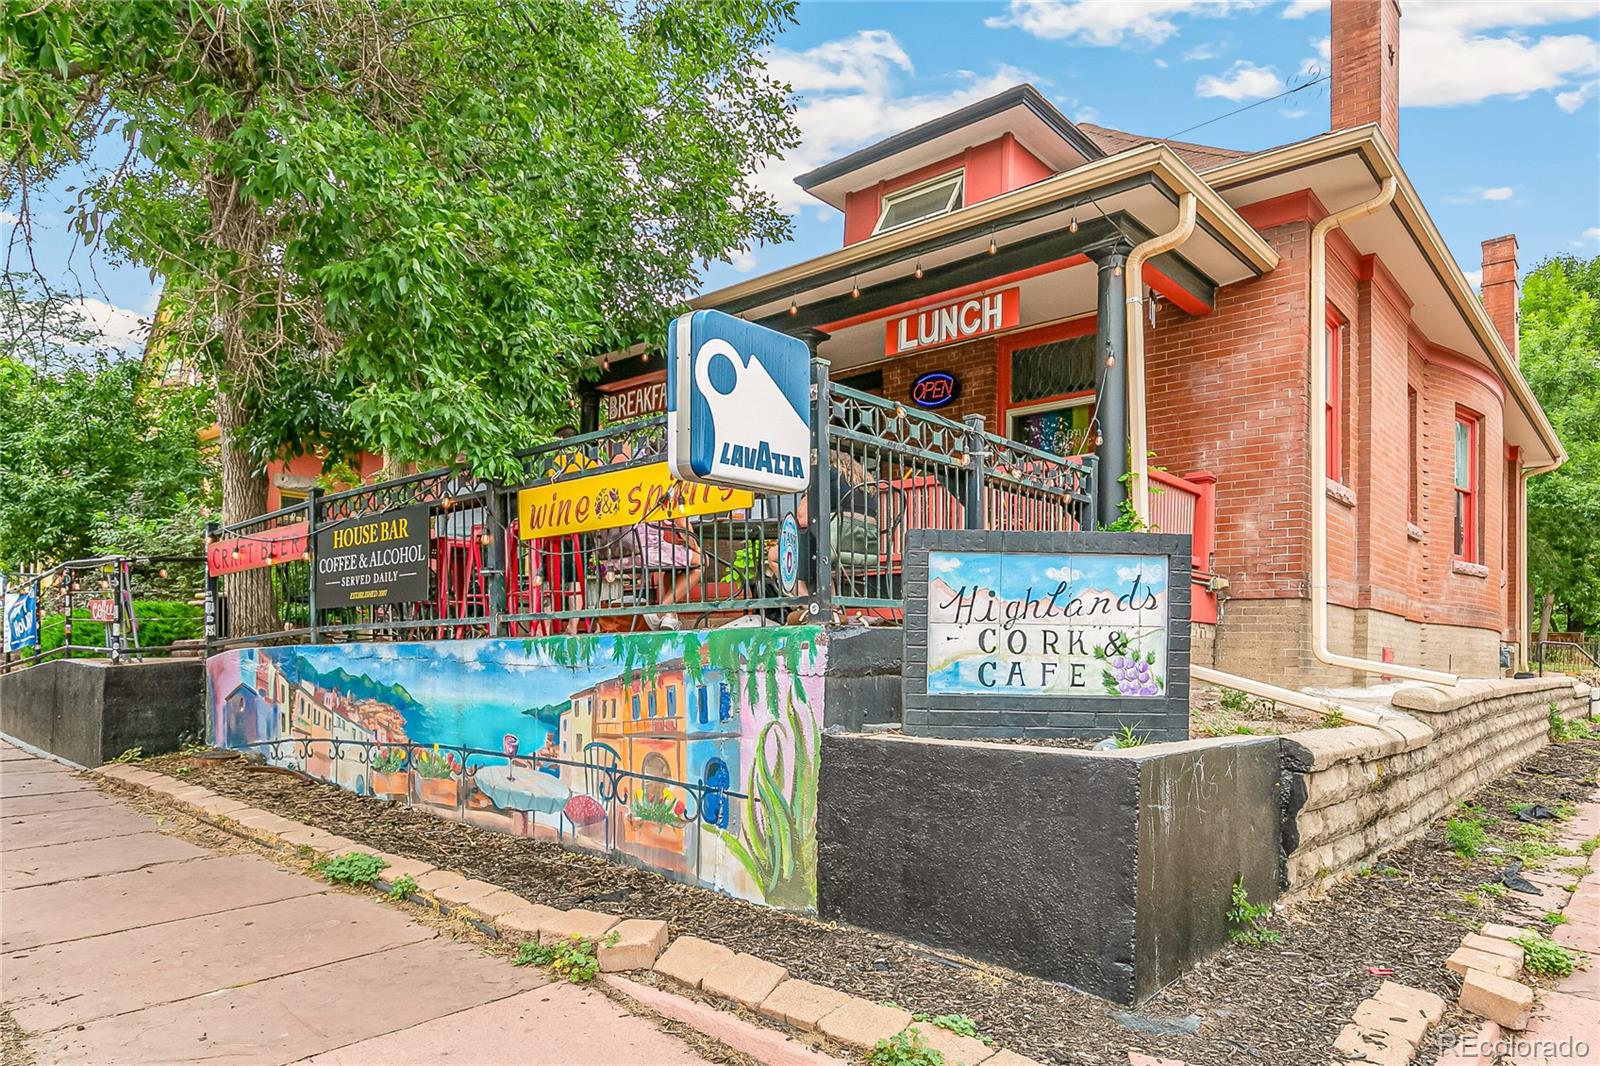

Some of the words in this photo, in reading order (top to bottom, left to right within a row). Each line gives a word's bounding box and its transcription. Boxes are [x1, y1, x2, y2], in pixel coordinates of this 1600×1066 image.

[897, 293, 1003, 353] LUNCH
[913, 379, 955, 401] OPEN
[720, 441, 804, 479] LAVAZZA
[529, 493, 590, 530] wine
[333, 523, 378, 549] HOUSE
[380, 518, 409, 542] BAR
[212, 542, 254, 570] CRAFT
[260, 534, 300, 561] BEER
[319, 554, 358, 574] COFFEE
[358, 553, 369, 569] &
[368, 544, 426, 568] ALCOHOL
[341, 573, 372, 587] SERVED
[373, 571, 399, 583] DAILY
[940, 574, 1160, 630] Highlands
[978, 627, 1090, 655] CORK
[1104, 630, 1128, 658] &
[978, 661, 1086, 688] CAFE
